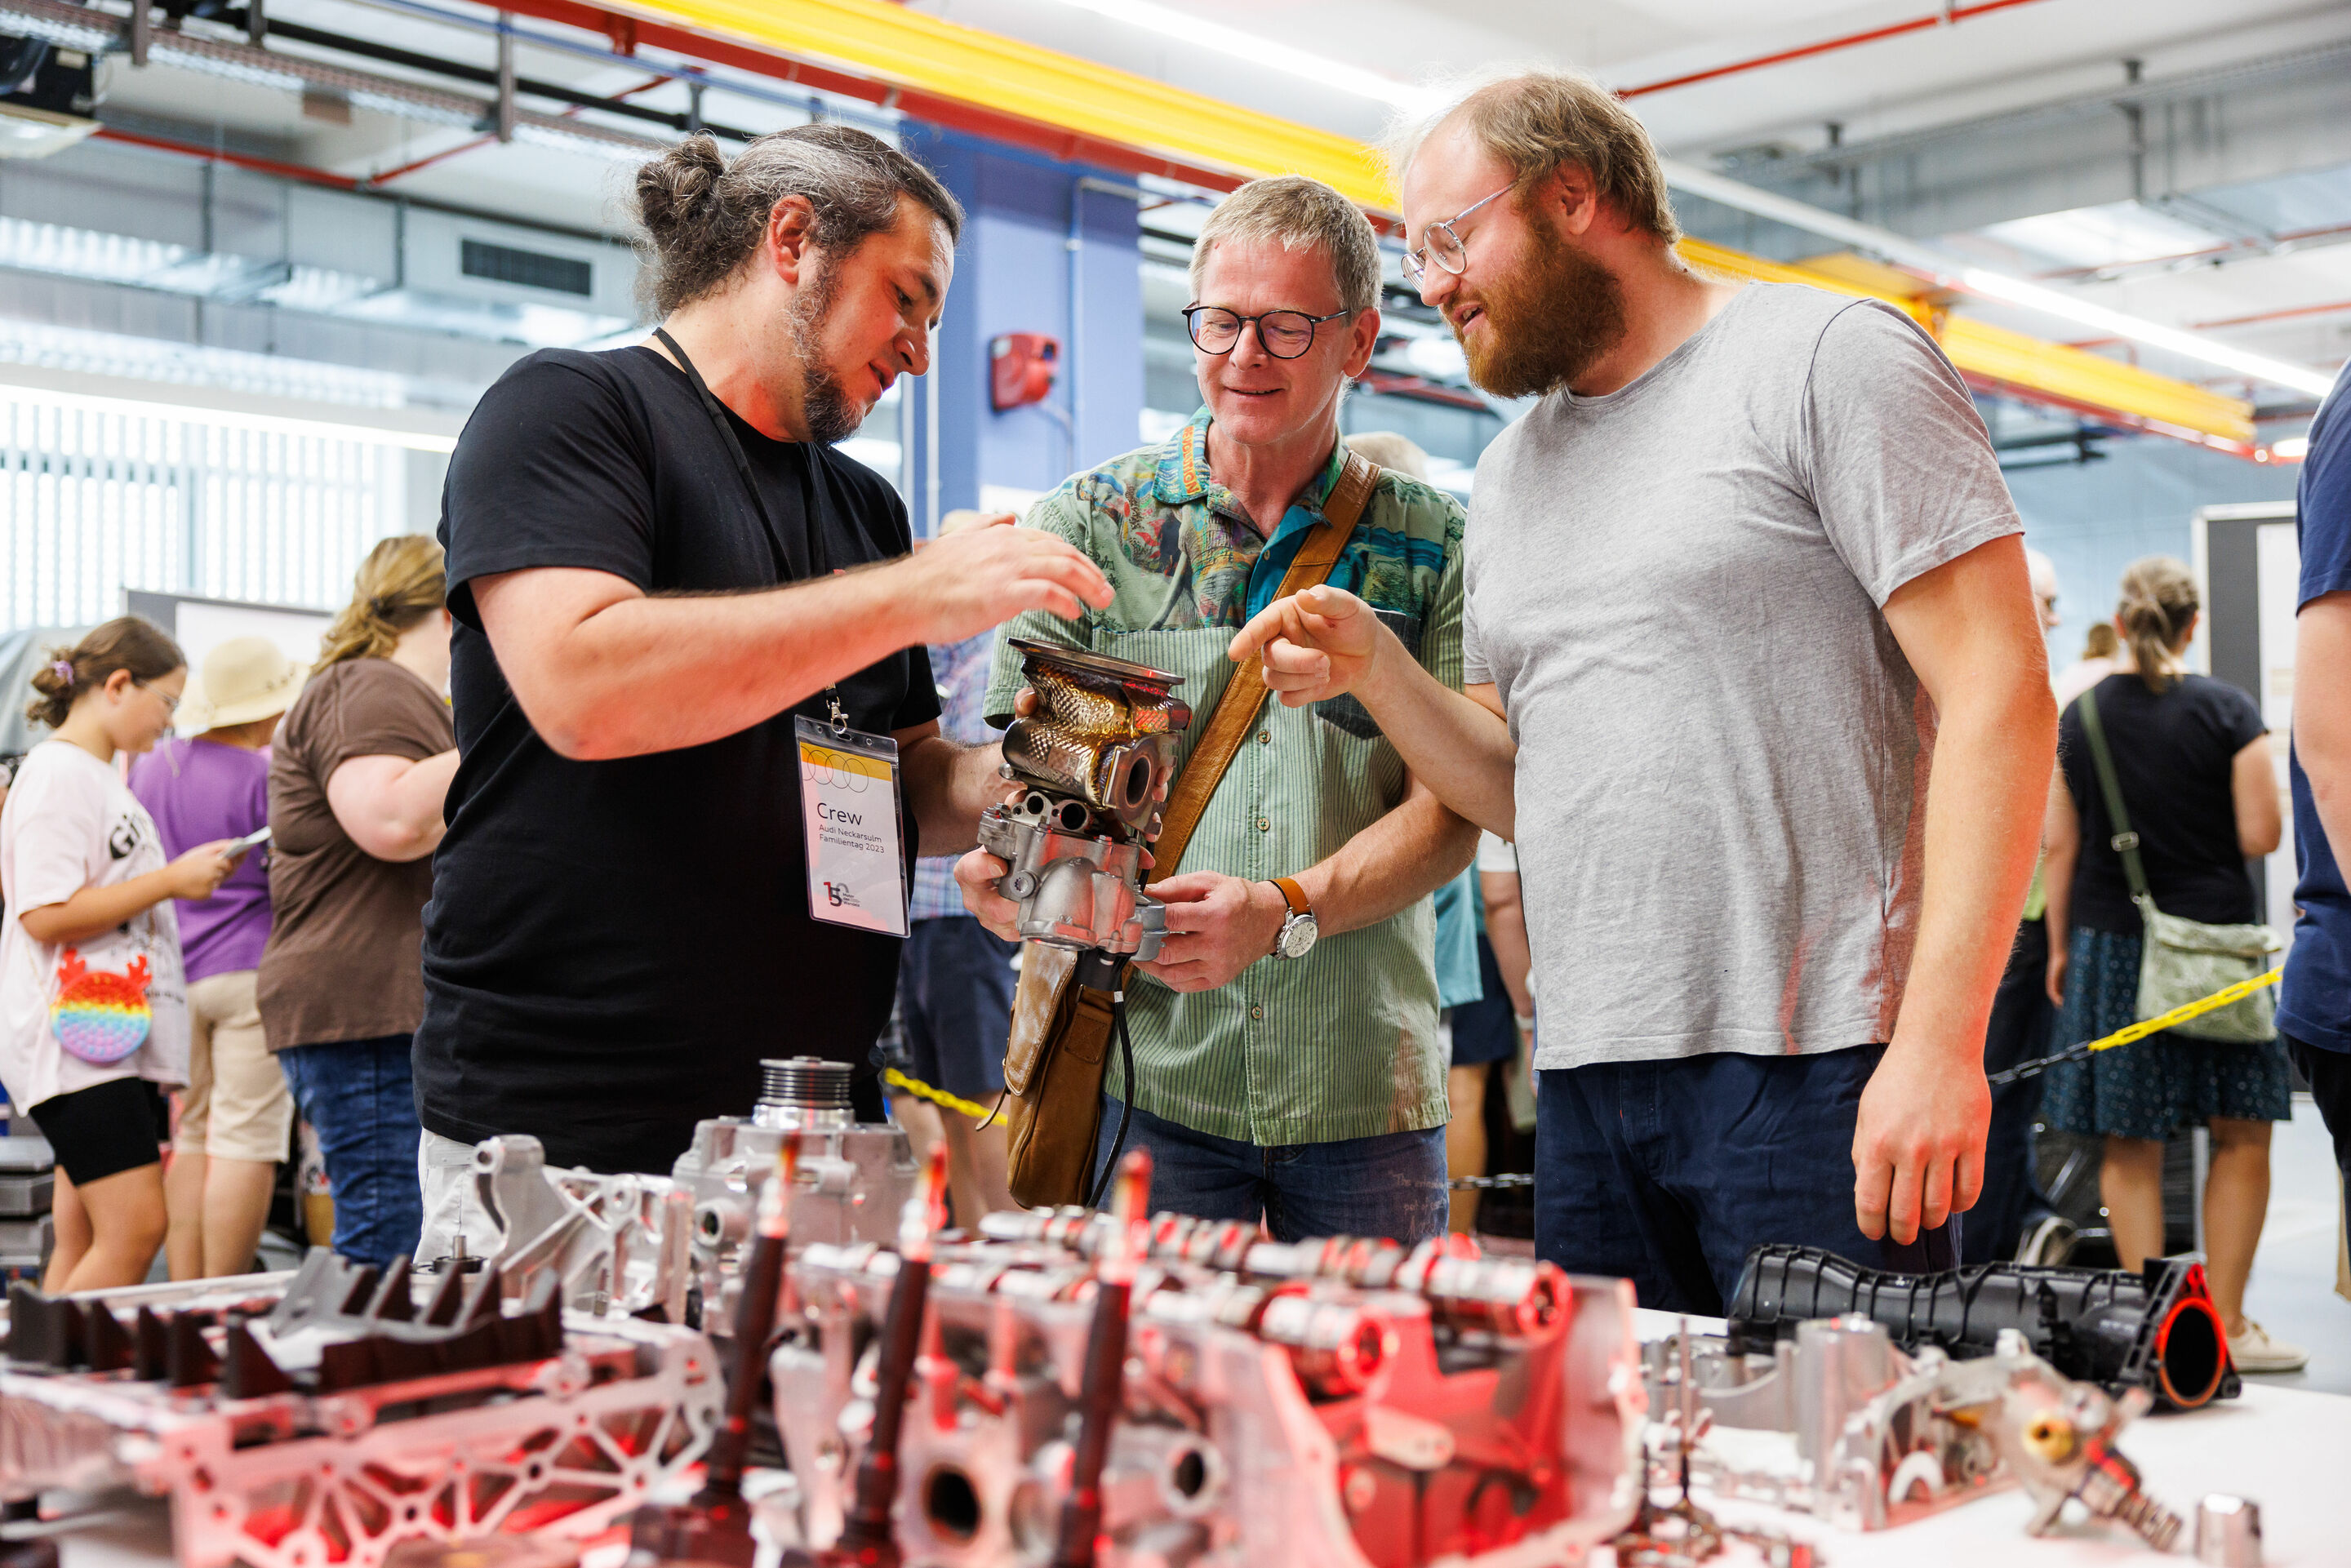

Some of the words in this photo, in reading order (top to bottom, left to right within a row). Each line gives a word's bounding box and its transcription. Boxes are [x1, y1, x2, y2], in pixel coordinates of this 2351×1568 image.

[817, 802, 862, 825] Crew
[819, 824, 837, 833] Audi
[838, 828, 882, 843] Neckarsulm
[819, 833, 864, 851] Familientag
[865, 843, 885, 854] 2023
